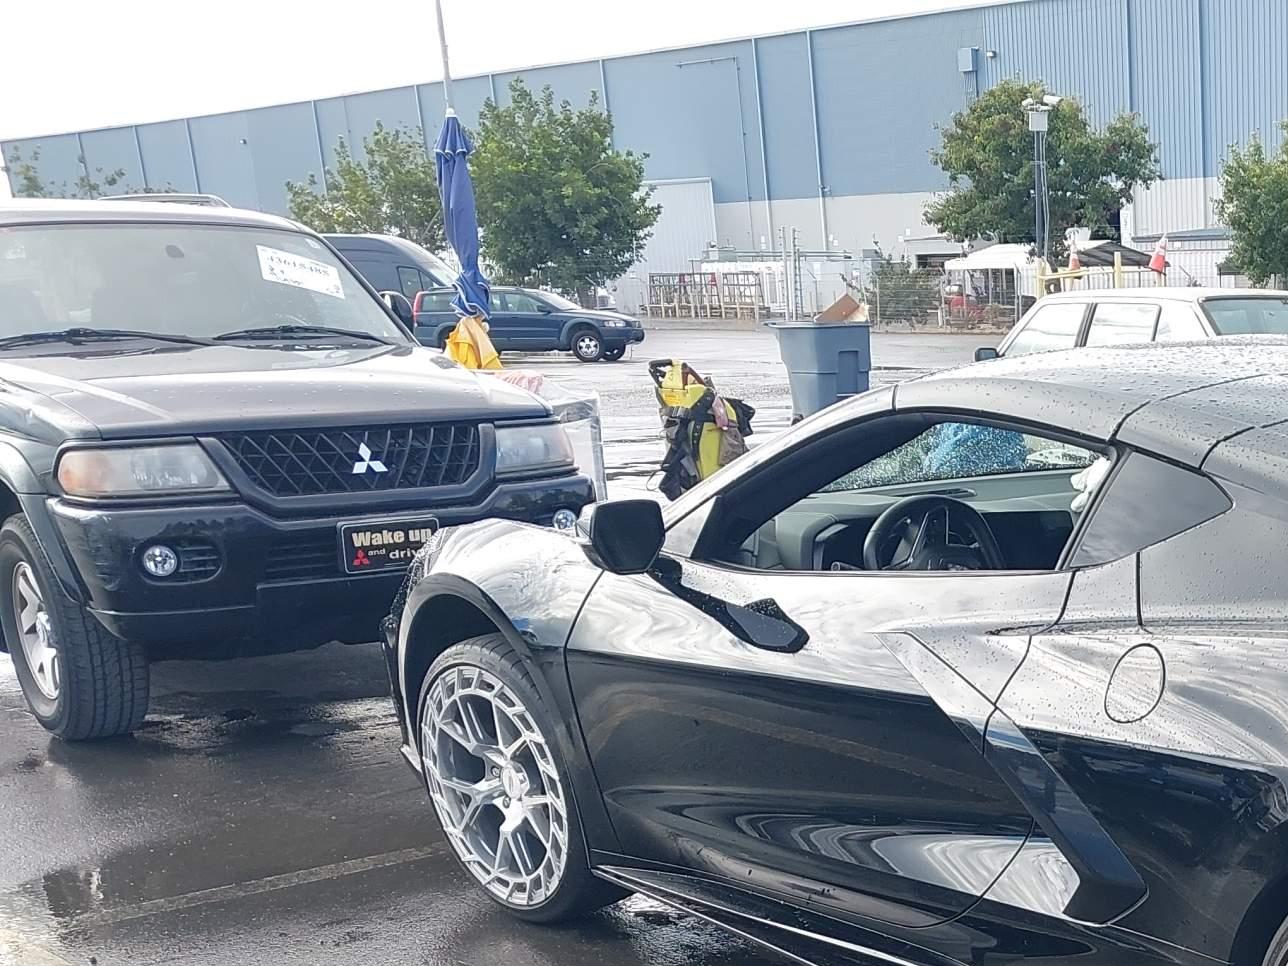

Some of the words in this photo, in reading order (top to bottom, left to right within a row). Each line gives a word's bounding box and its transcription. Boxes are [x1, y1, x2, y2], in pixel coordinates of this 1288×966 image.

[352, 530, 405, 547] Wake
[408, 528, 432, 543] up
[368, 548, 386, 556] and
[389, 548, 421, 559] driv
